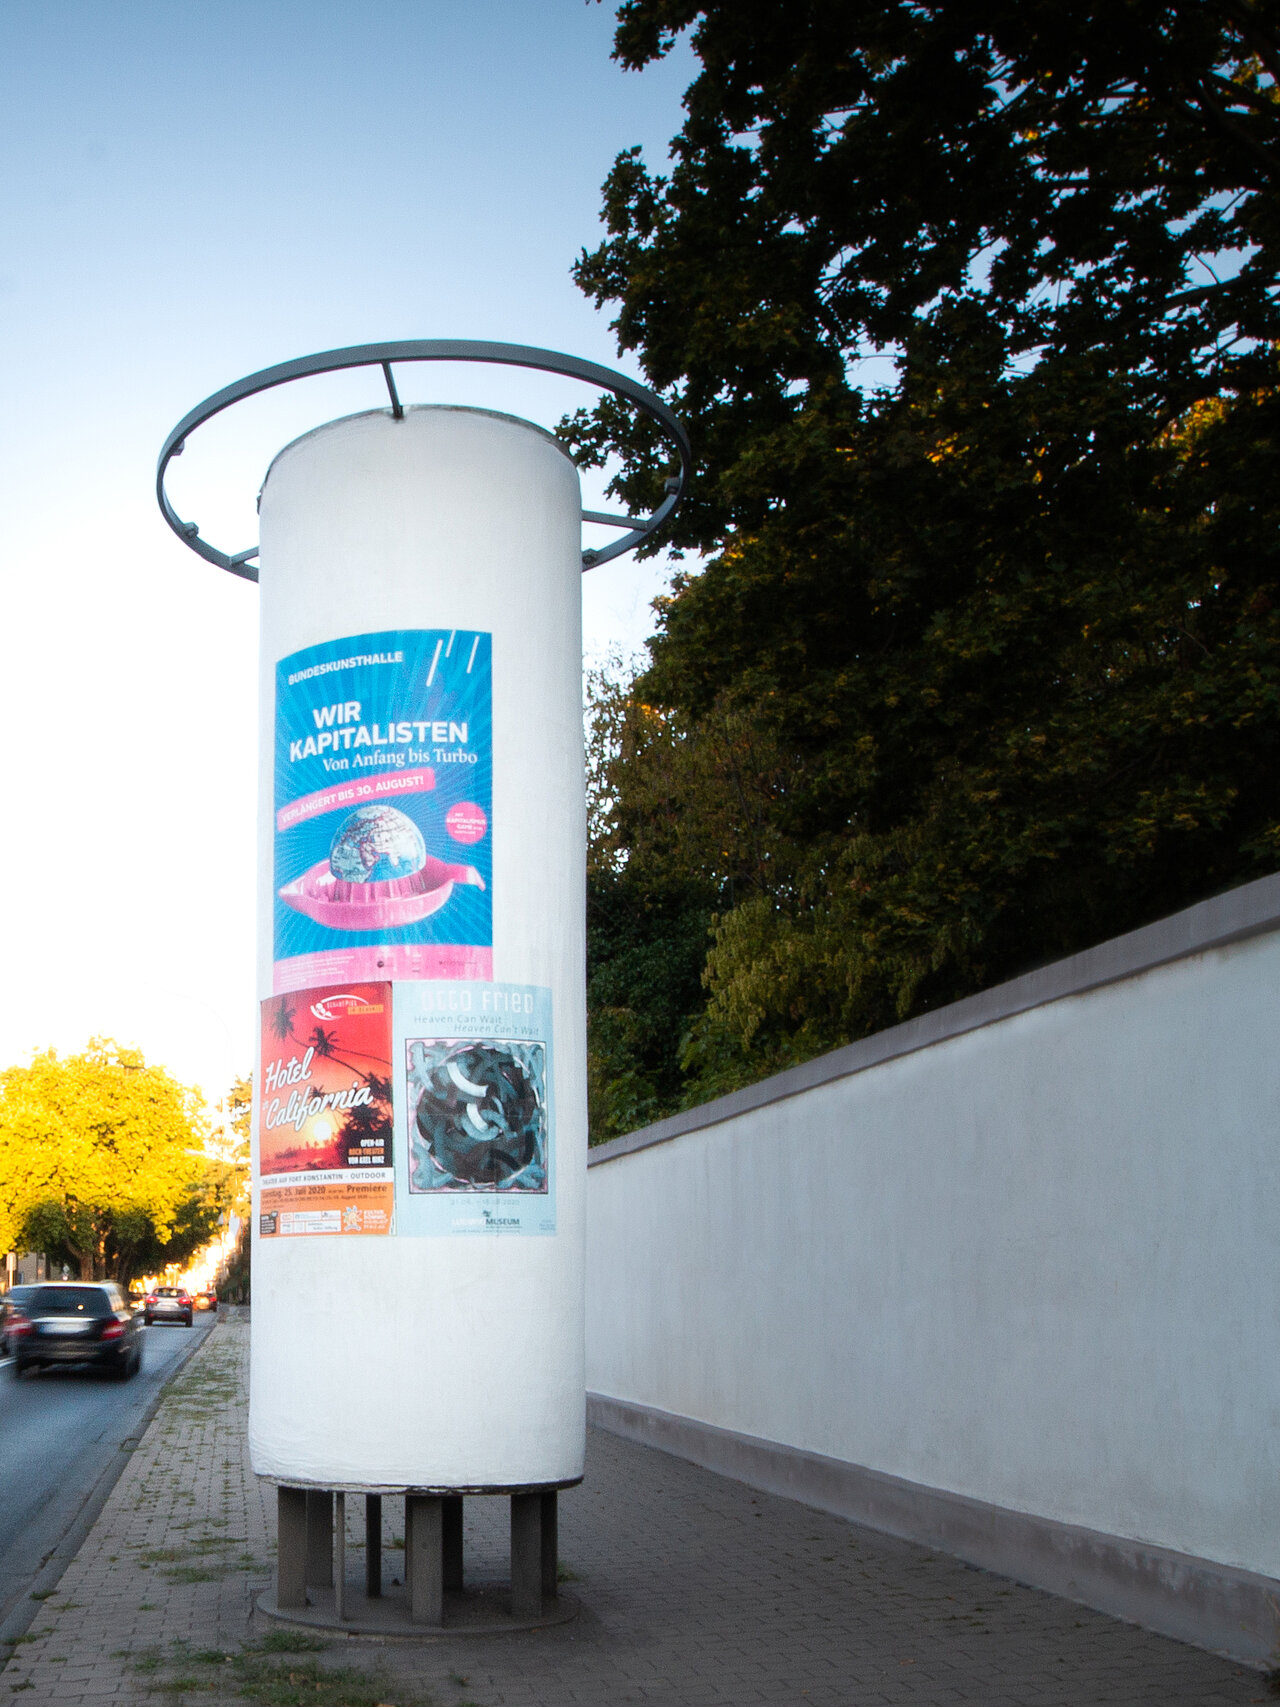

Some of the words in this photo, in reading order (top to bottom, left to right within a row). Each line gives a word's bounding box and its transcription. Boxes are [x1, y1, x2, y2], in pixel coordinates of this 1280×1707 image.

[288, 650, 404, 686] BUNDESKUNSTHALLE
[313, 700, 361, 729] WIR
[289, 721, 468, 763] KAPITALISTEN
[323, 758, 349, 772] Von
[352, 749, 406, 768] Anfang
[409, 747, 430, 763] bis
[433, 747, 478, 764] Turbo
[281, 794, 337, 823] VERLÄNGERT
[338, 788, 355, 802] BIS
[356, 785, 374, 797] 30.
[376, 775, 424, 792] AUGUST!
[414, 1014, 453, 1024] Heaven
[456, 1014, 477, 1024] Can
[480, 1014, 503, 1025] Wait
[454, 1024, 491, 1034] Heaven
[494, 1024, 518, 1034] Can't
[520, 1026, 539, 1036] Wait
[265, 1046, 314, 1094] Hotel
[265, 1081, 374, 1132] California
[308, 1185, 326, 1195] 2020
[346, 1184, 388, 1192] Premiere
